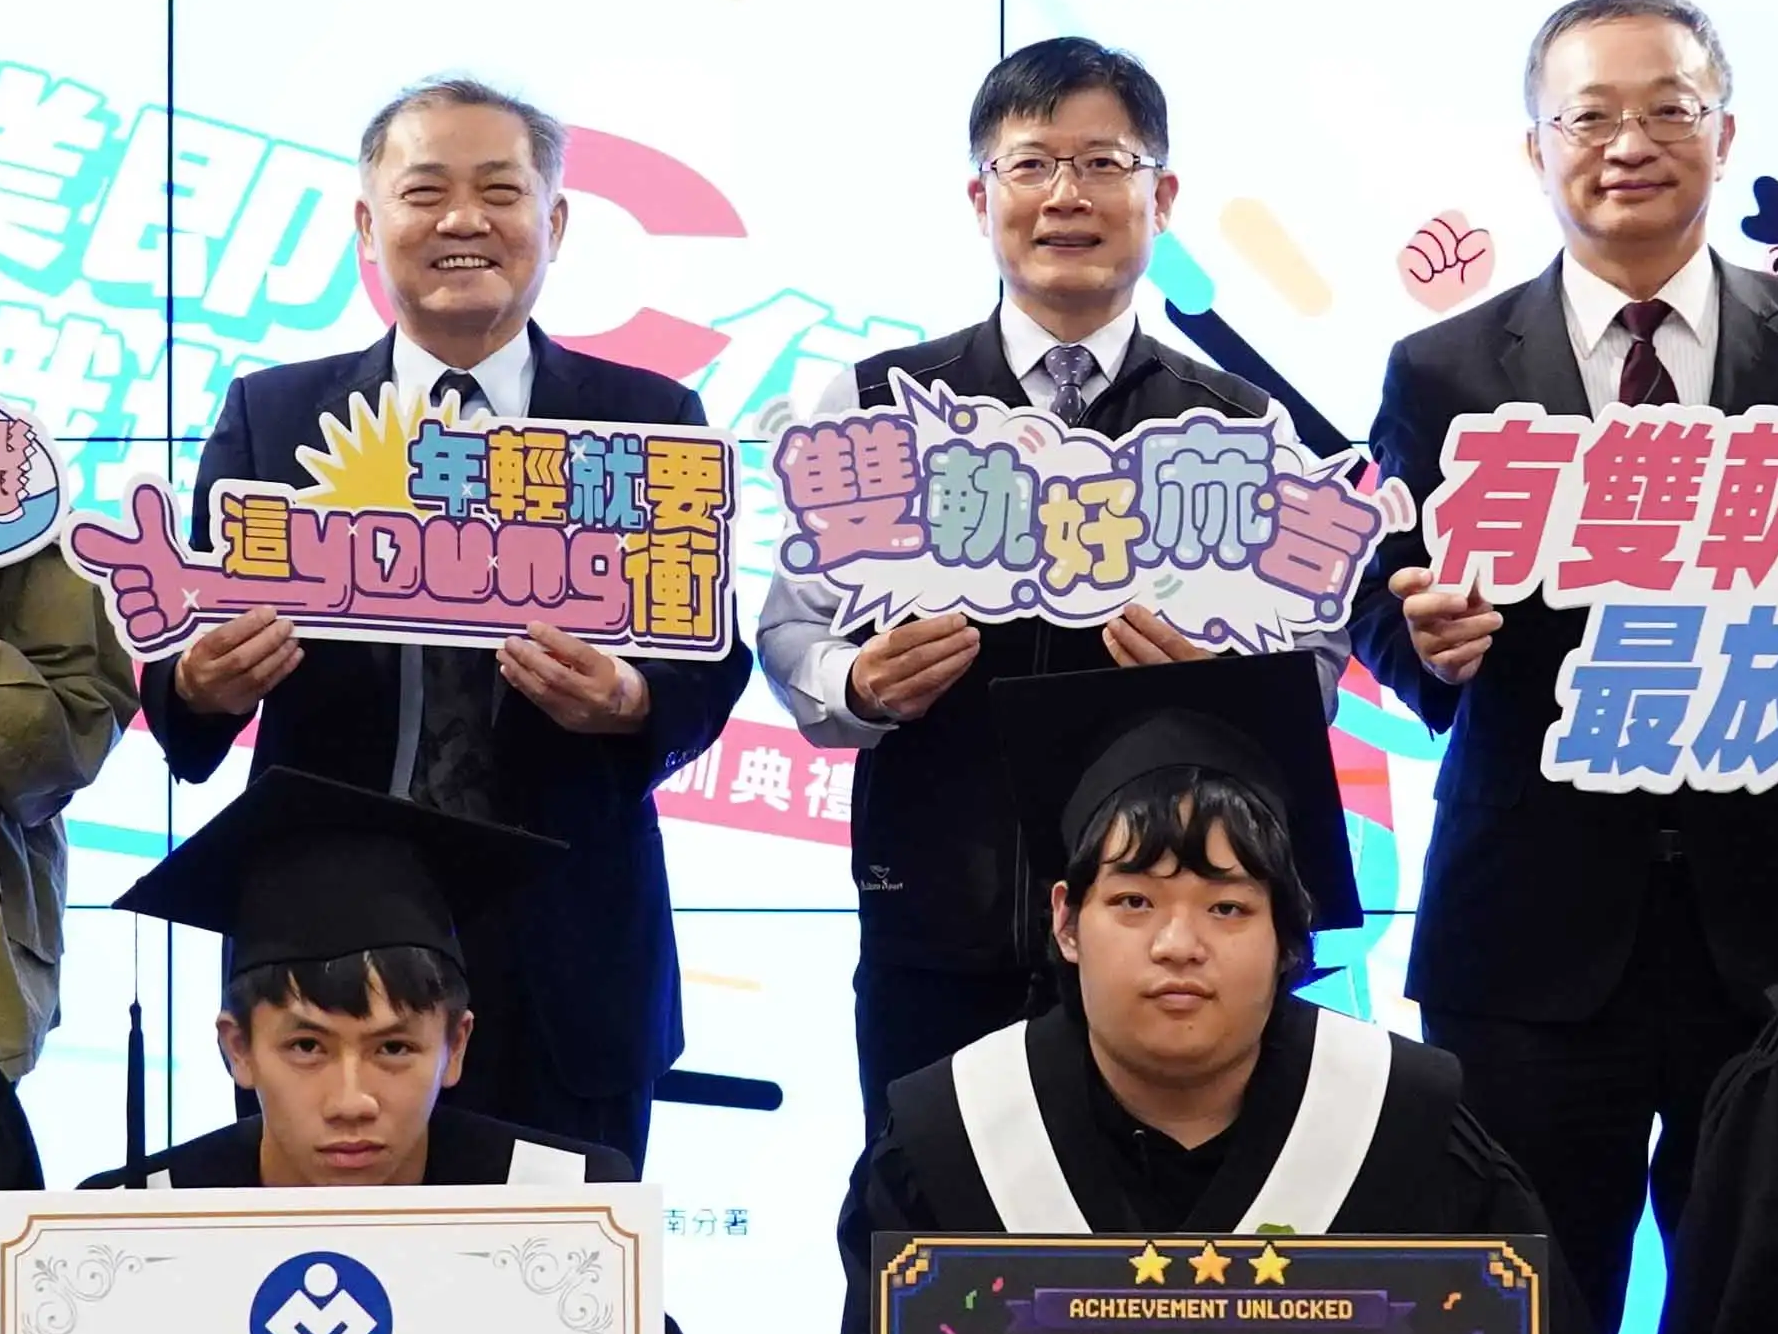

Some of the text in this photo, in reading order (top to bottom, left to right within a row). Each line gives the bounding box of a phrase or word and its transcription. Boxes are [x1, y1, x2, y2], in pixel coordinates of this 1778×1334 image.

[412, 419, 726, 530] 年輕就要
[781, 417, 1381, 594] 雙軌好麻吉
[1070, 1298, 1353, 1322] ACHIEVEMENT UNLOCKED
